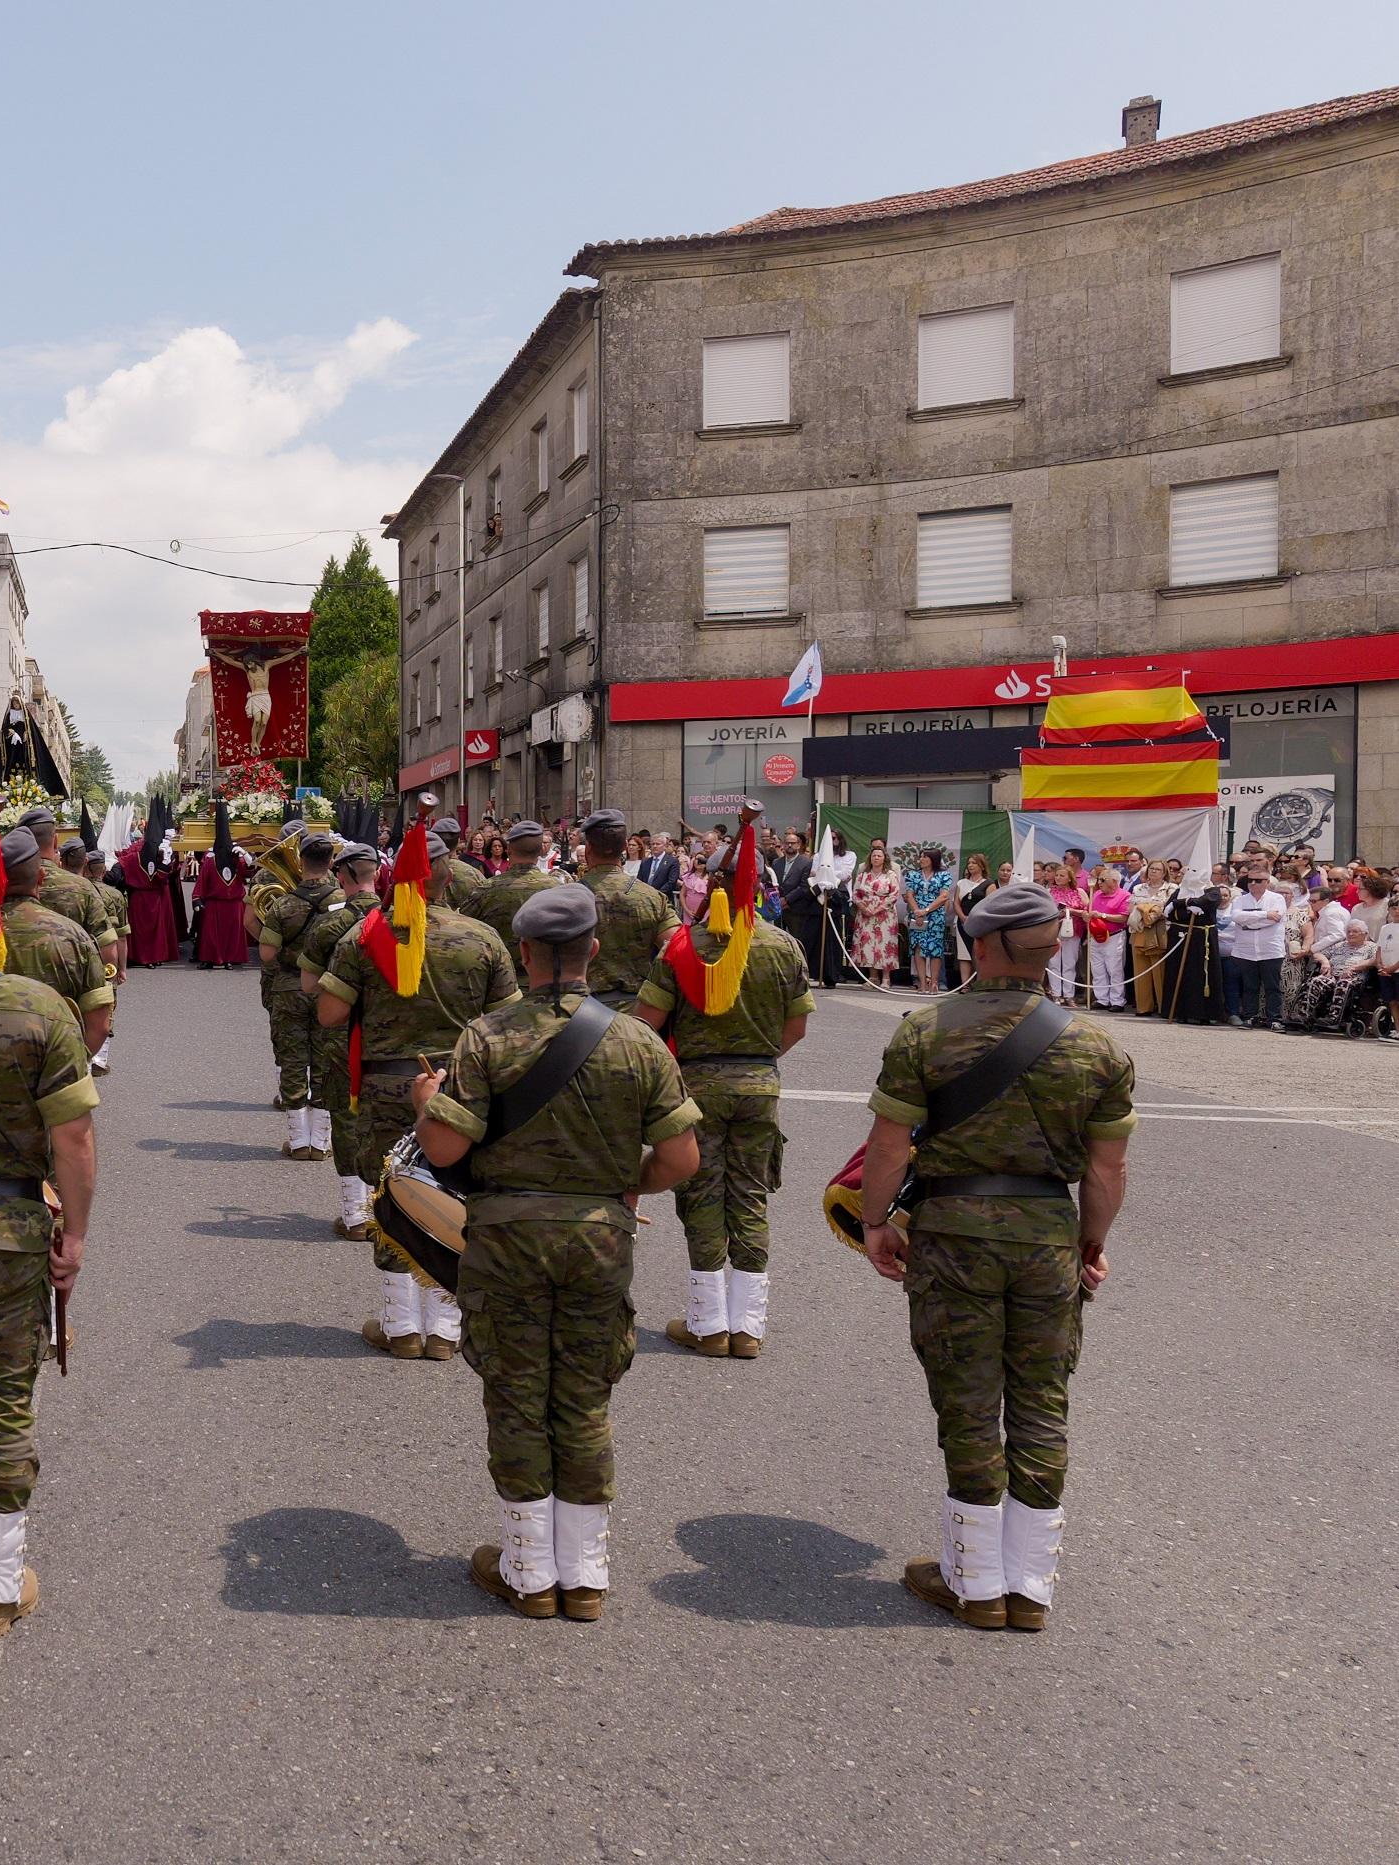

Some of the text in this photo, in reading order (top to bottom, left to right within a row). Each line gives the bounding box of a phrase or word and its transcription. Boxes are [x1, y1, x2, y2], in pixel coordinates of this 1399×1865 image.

[1206, 695, 1338, 718] RELOJERÍA
[708, 723, 787, 742] JOYERÍA
[866, 715, 974, 735] RELOJERÍA
[1218, 784, 1264, 795] OTENS
[689, 794, 747, 804] DESCUENTOS
[700, 805, 743, 815] ENAMORA
